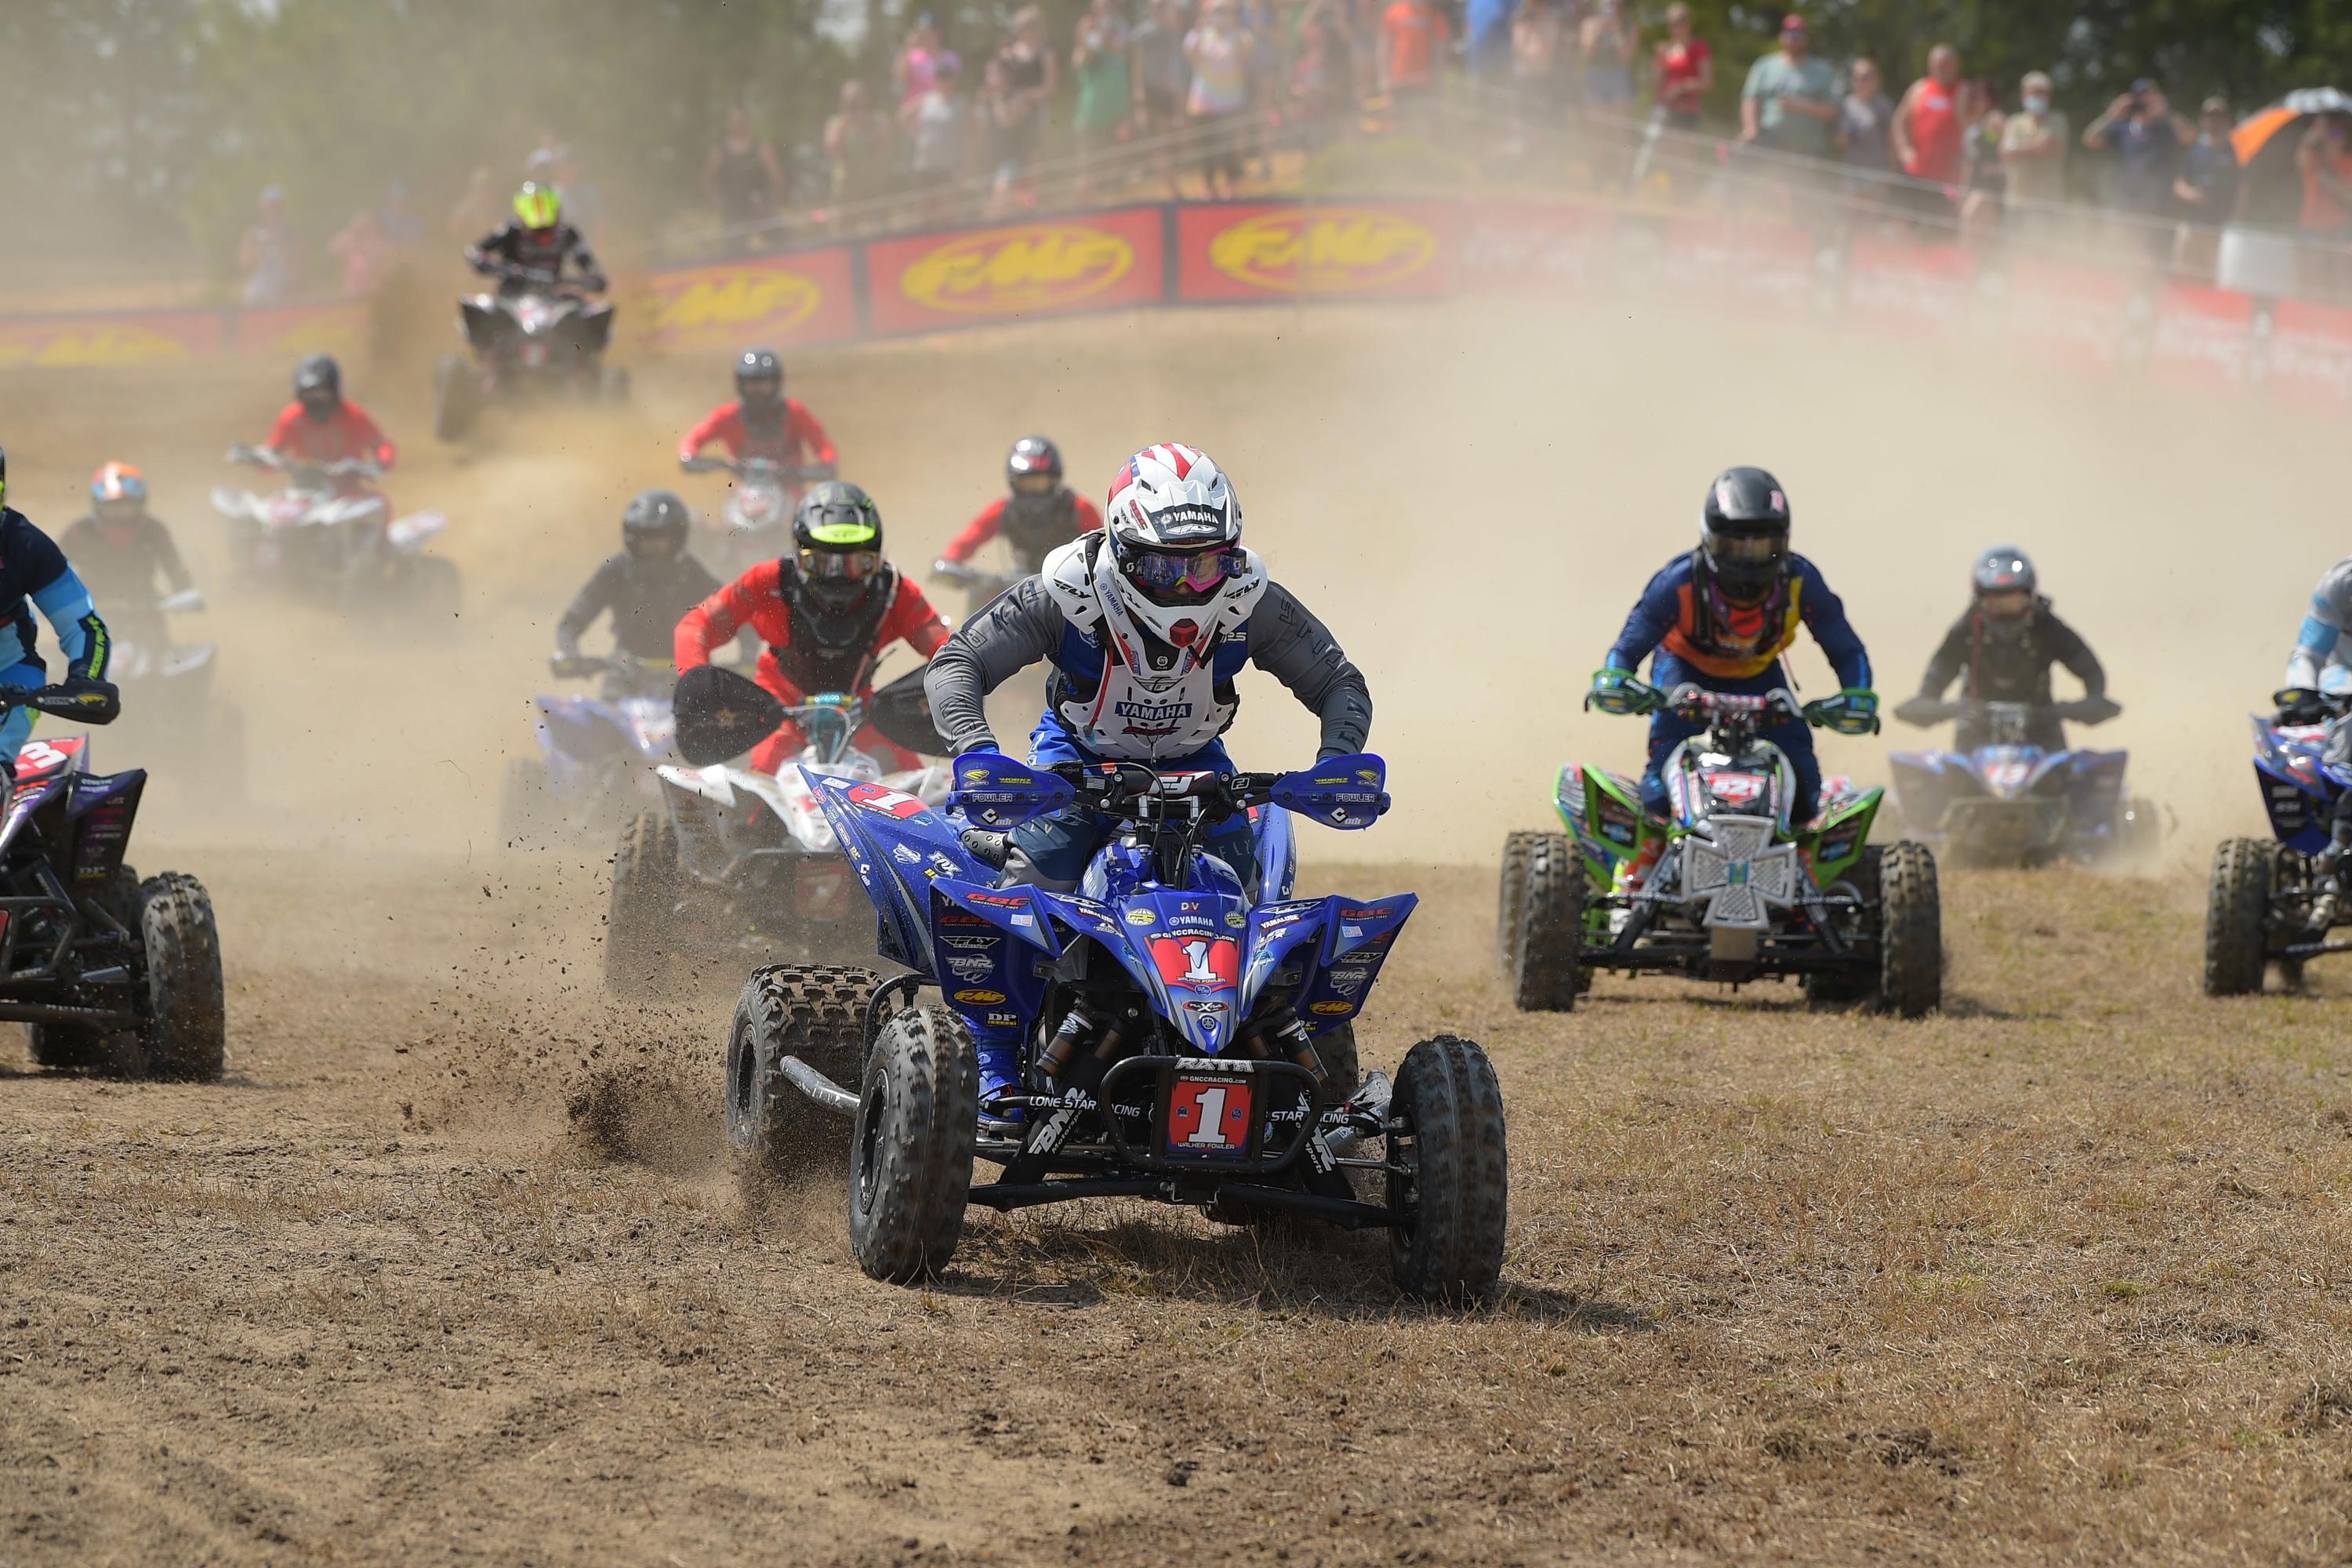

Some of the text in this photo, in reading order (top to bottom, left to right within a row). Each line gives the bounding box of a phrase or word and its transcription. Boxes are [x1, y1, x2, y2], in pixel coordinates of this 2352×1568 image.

[1212, 220, 1428, 270] FMF
[904, 235, 1126, 301] FMF
[1173, 510, 1219, 524] YAMAHA
[1168, 524, 1218, 535] FLY
[1053, 579, 1092, 598] FLY
[1223, 579, 1261, 600] FLY
[1104, 590, 1124, 617] YAMAHA
[1121, 703, 1187, 720] YAMAHA
[20, 742, 68, 769] 3
[862, 791, 916, 811] 1
[972, 793, 1012, 803] FOWLER
[1336, 793, 1375, 803] FOWLER
[1218, 839, 1250, 860] FLY
[927, 851, 964, 872] FOX
[966, 893, 1032, 906] GBC
[1127, 914, 1156, 923] GPS
[1341, 907, 1393, 917] GBC
[1179, 916, 1214, 927] YAMAHA
[1261, 914, 1300, 928] YAMALUBE
[940, 936, 1000, 946] FLY
[949, 957, 993, 967] BNR
[1182, 941, 1218, 979] 1
[954, 991, 1007, 1003] FMF
[1310, 1003, 1353, 1011] FMF
[1174, 1058, 1254, 1073] RATH
[1029, 1096, 1062, 1107] LONE
[1064, 1098, 1097, 1110] STAR
[1188, 1087, 1226, 1144] 1
[1271, 1111, 1305, 1122] STAR
